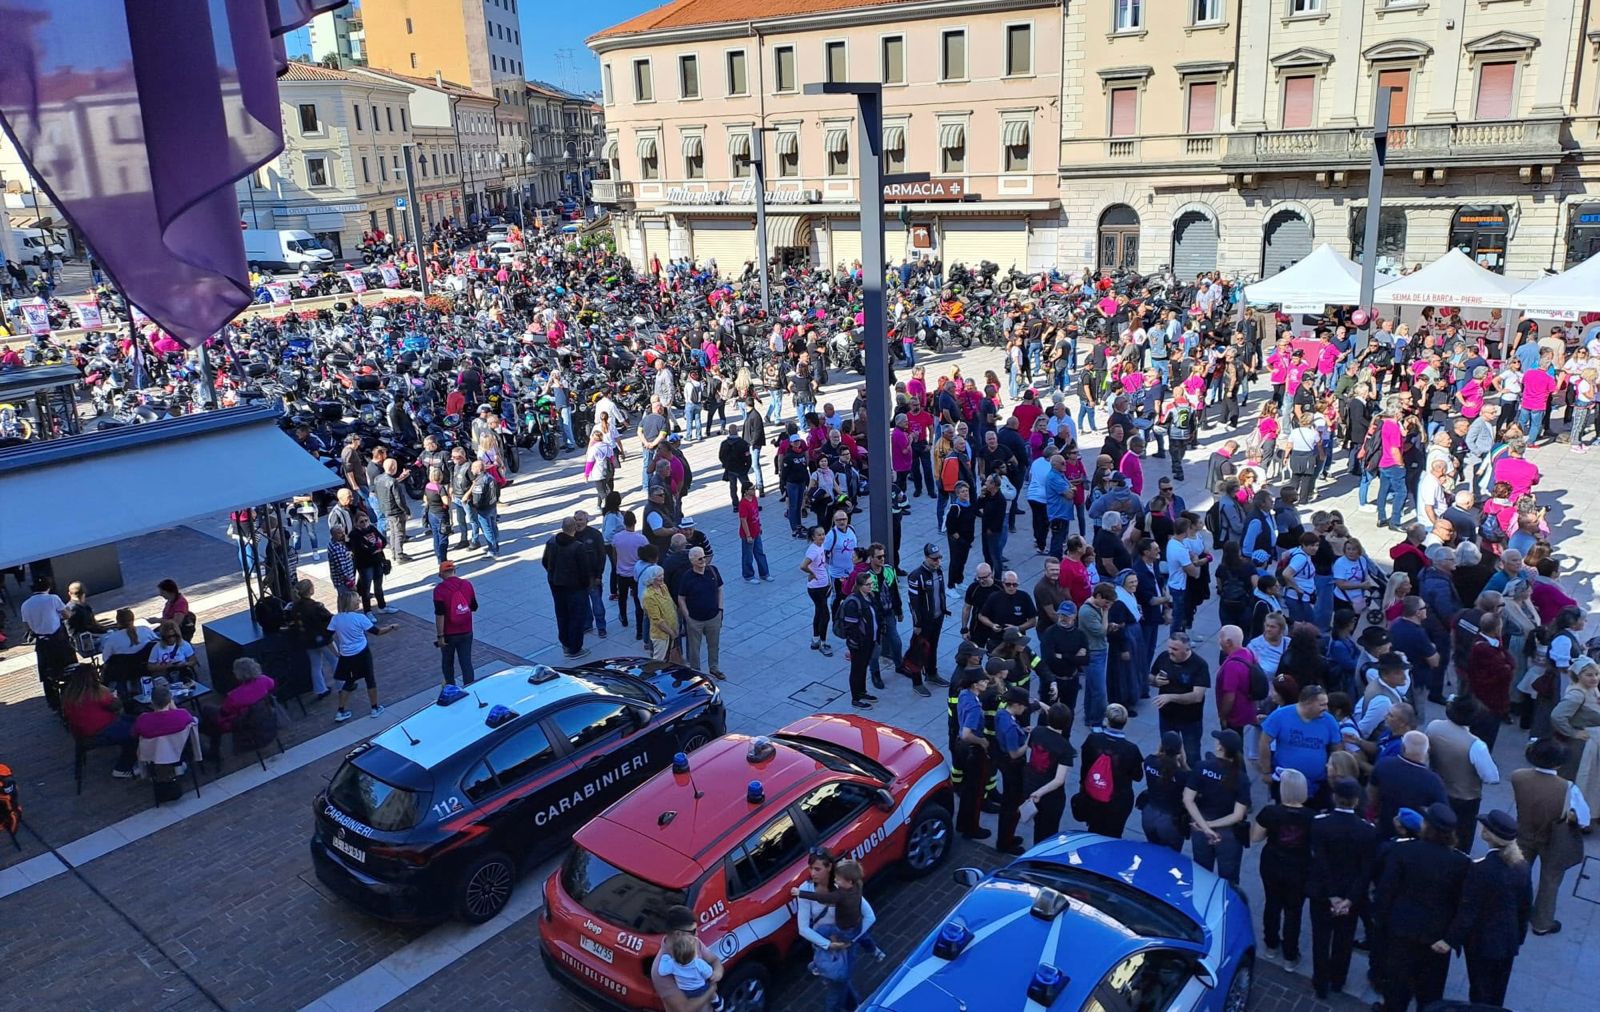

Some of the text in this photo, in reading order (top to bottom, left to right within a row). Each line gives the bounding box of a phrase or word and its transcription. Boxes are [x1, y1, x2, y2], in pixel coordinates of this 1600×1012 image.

[883, 183, 944, 196] ARMACIA
[1202, 769, 1222, 780] POLI
[535, 751, 648, 826] CARABINIERI
[432, 796, 460, 818] 112
[324, 805, 374, 838] CARABINIERI
[850, 826, 885, 861] FUOCO
[708, 899, 724, 918] 115
[583, 919, 602, 936] Jeep
[626, 935, 644, 951] 115
[561, 951, 627, 995] VIGILI DEL FUOCO
